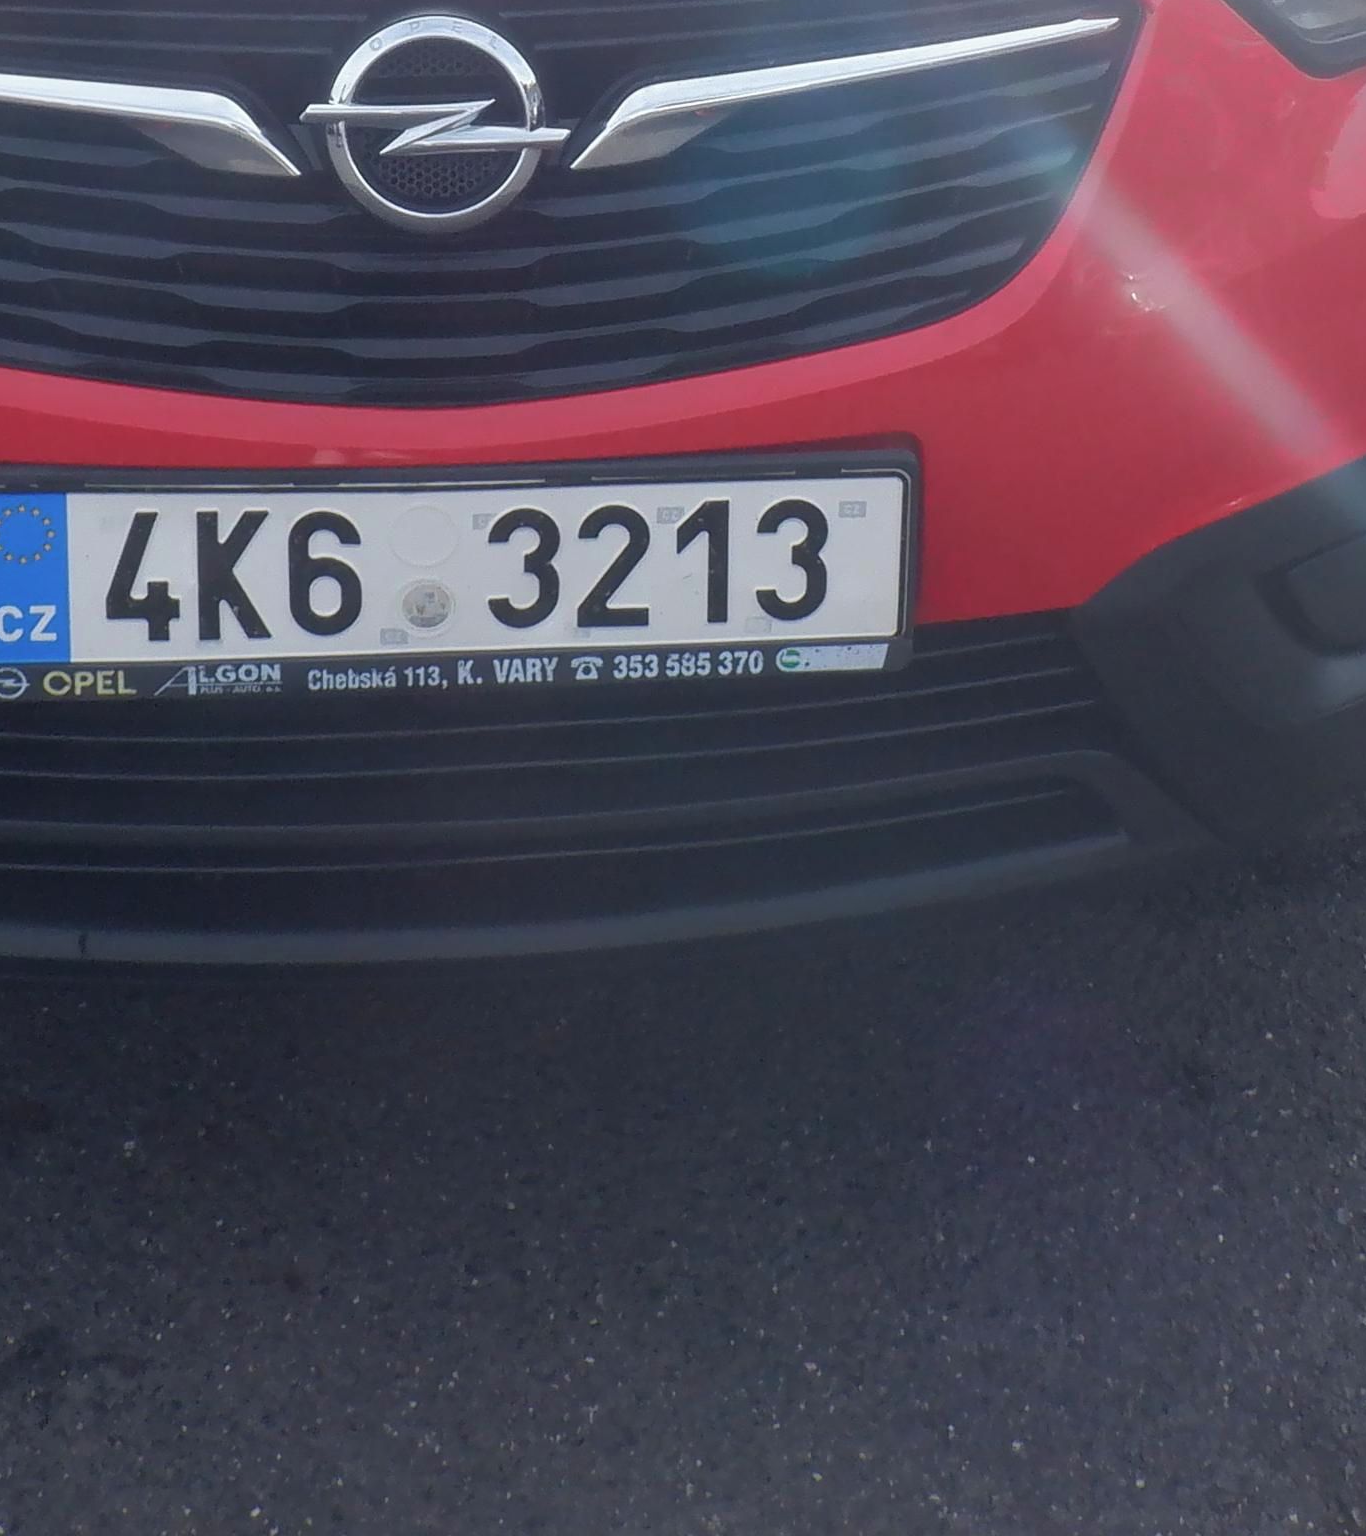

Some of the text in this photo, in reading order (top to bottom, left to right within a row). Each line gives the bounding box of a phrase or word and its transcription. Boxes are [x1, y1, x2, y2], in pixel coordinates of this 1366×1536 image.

[369, 21, 501, 51] OPEL
[106, 498, 829, 641] 4K6 3213
[43, 670, 137, 695] OPEL
[154, 663, 282, 696] ALGON
[308, 649, 764, 691] Chebská 113, K. VARY 353 585 370
